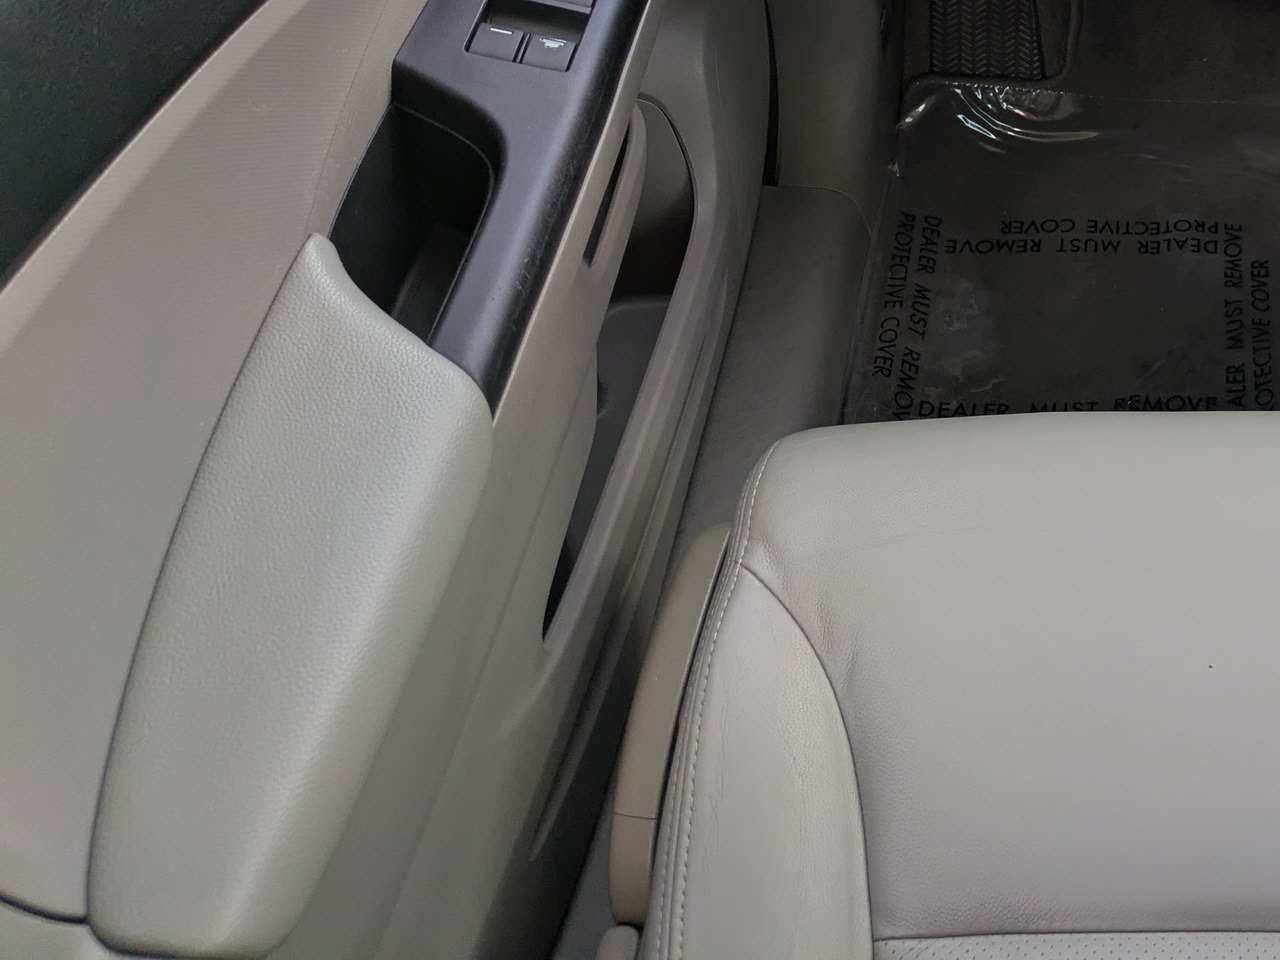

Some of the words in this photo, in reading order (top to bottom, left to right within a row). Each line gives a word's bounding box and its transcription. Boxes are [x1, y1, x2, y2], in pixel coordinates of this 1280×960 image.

[918, 215, 943, 275] DEALER
[943, 238, 1042, 254] REMOVE
[1001, 218, 1075, 234] COVER
[1056, 238, 1120, 254] MUST
[1088, 219, 1218, 235] PROTECTIVE
[1137, 238, 1218, 255] DEALER
[883, 211, 917, 309] PROTECTIVE
[1223, 223, 1244, 289] REMOVE
[908, 283, 932, 341] MUST
[1250, 260, 1271, 313] COVER
[871, 316, 900, 378] COVER
[1224, 299, 1245, 350] MUST
